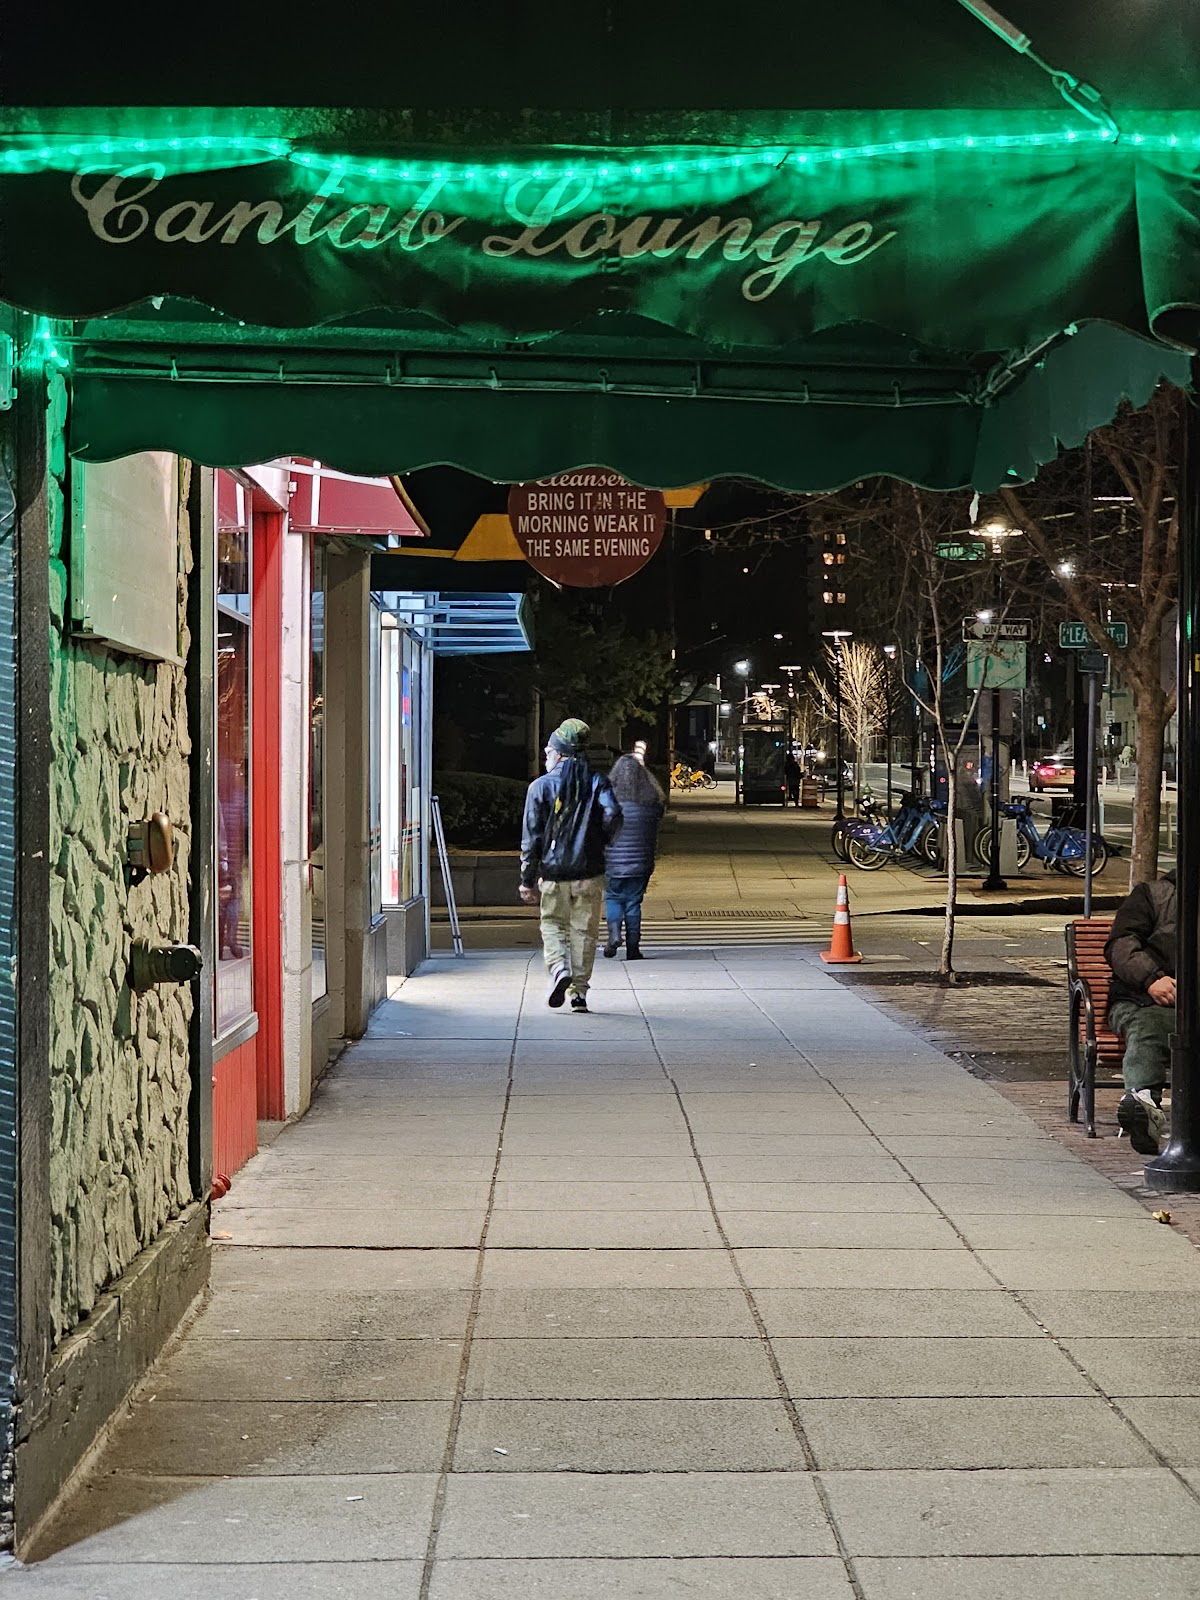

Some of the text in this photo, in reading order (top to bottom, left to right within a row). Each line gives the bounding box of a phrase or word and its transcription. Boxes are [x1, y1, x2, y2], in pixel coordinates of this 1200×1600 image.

[71, 163, 897, 302] Cantab Lounge
[529, 492, 647, 511] BRING IT IN THE
[518, 514, 656, 533] MORNING WEAR IT
[526, 538, 650, 557] THE SAME EVENING
[1005, 625, 1025, 636] WAY
